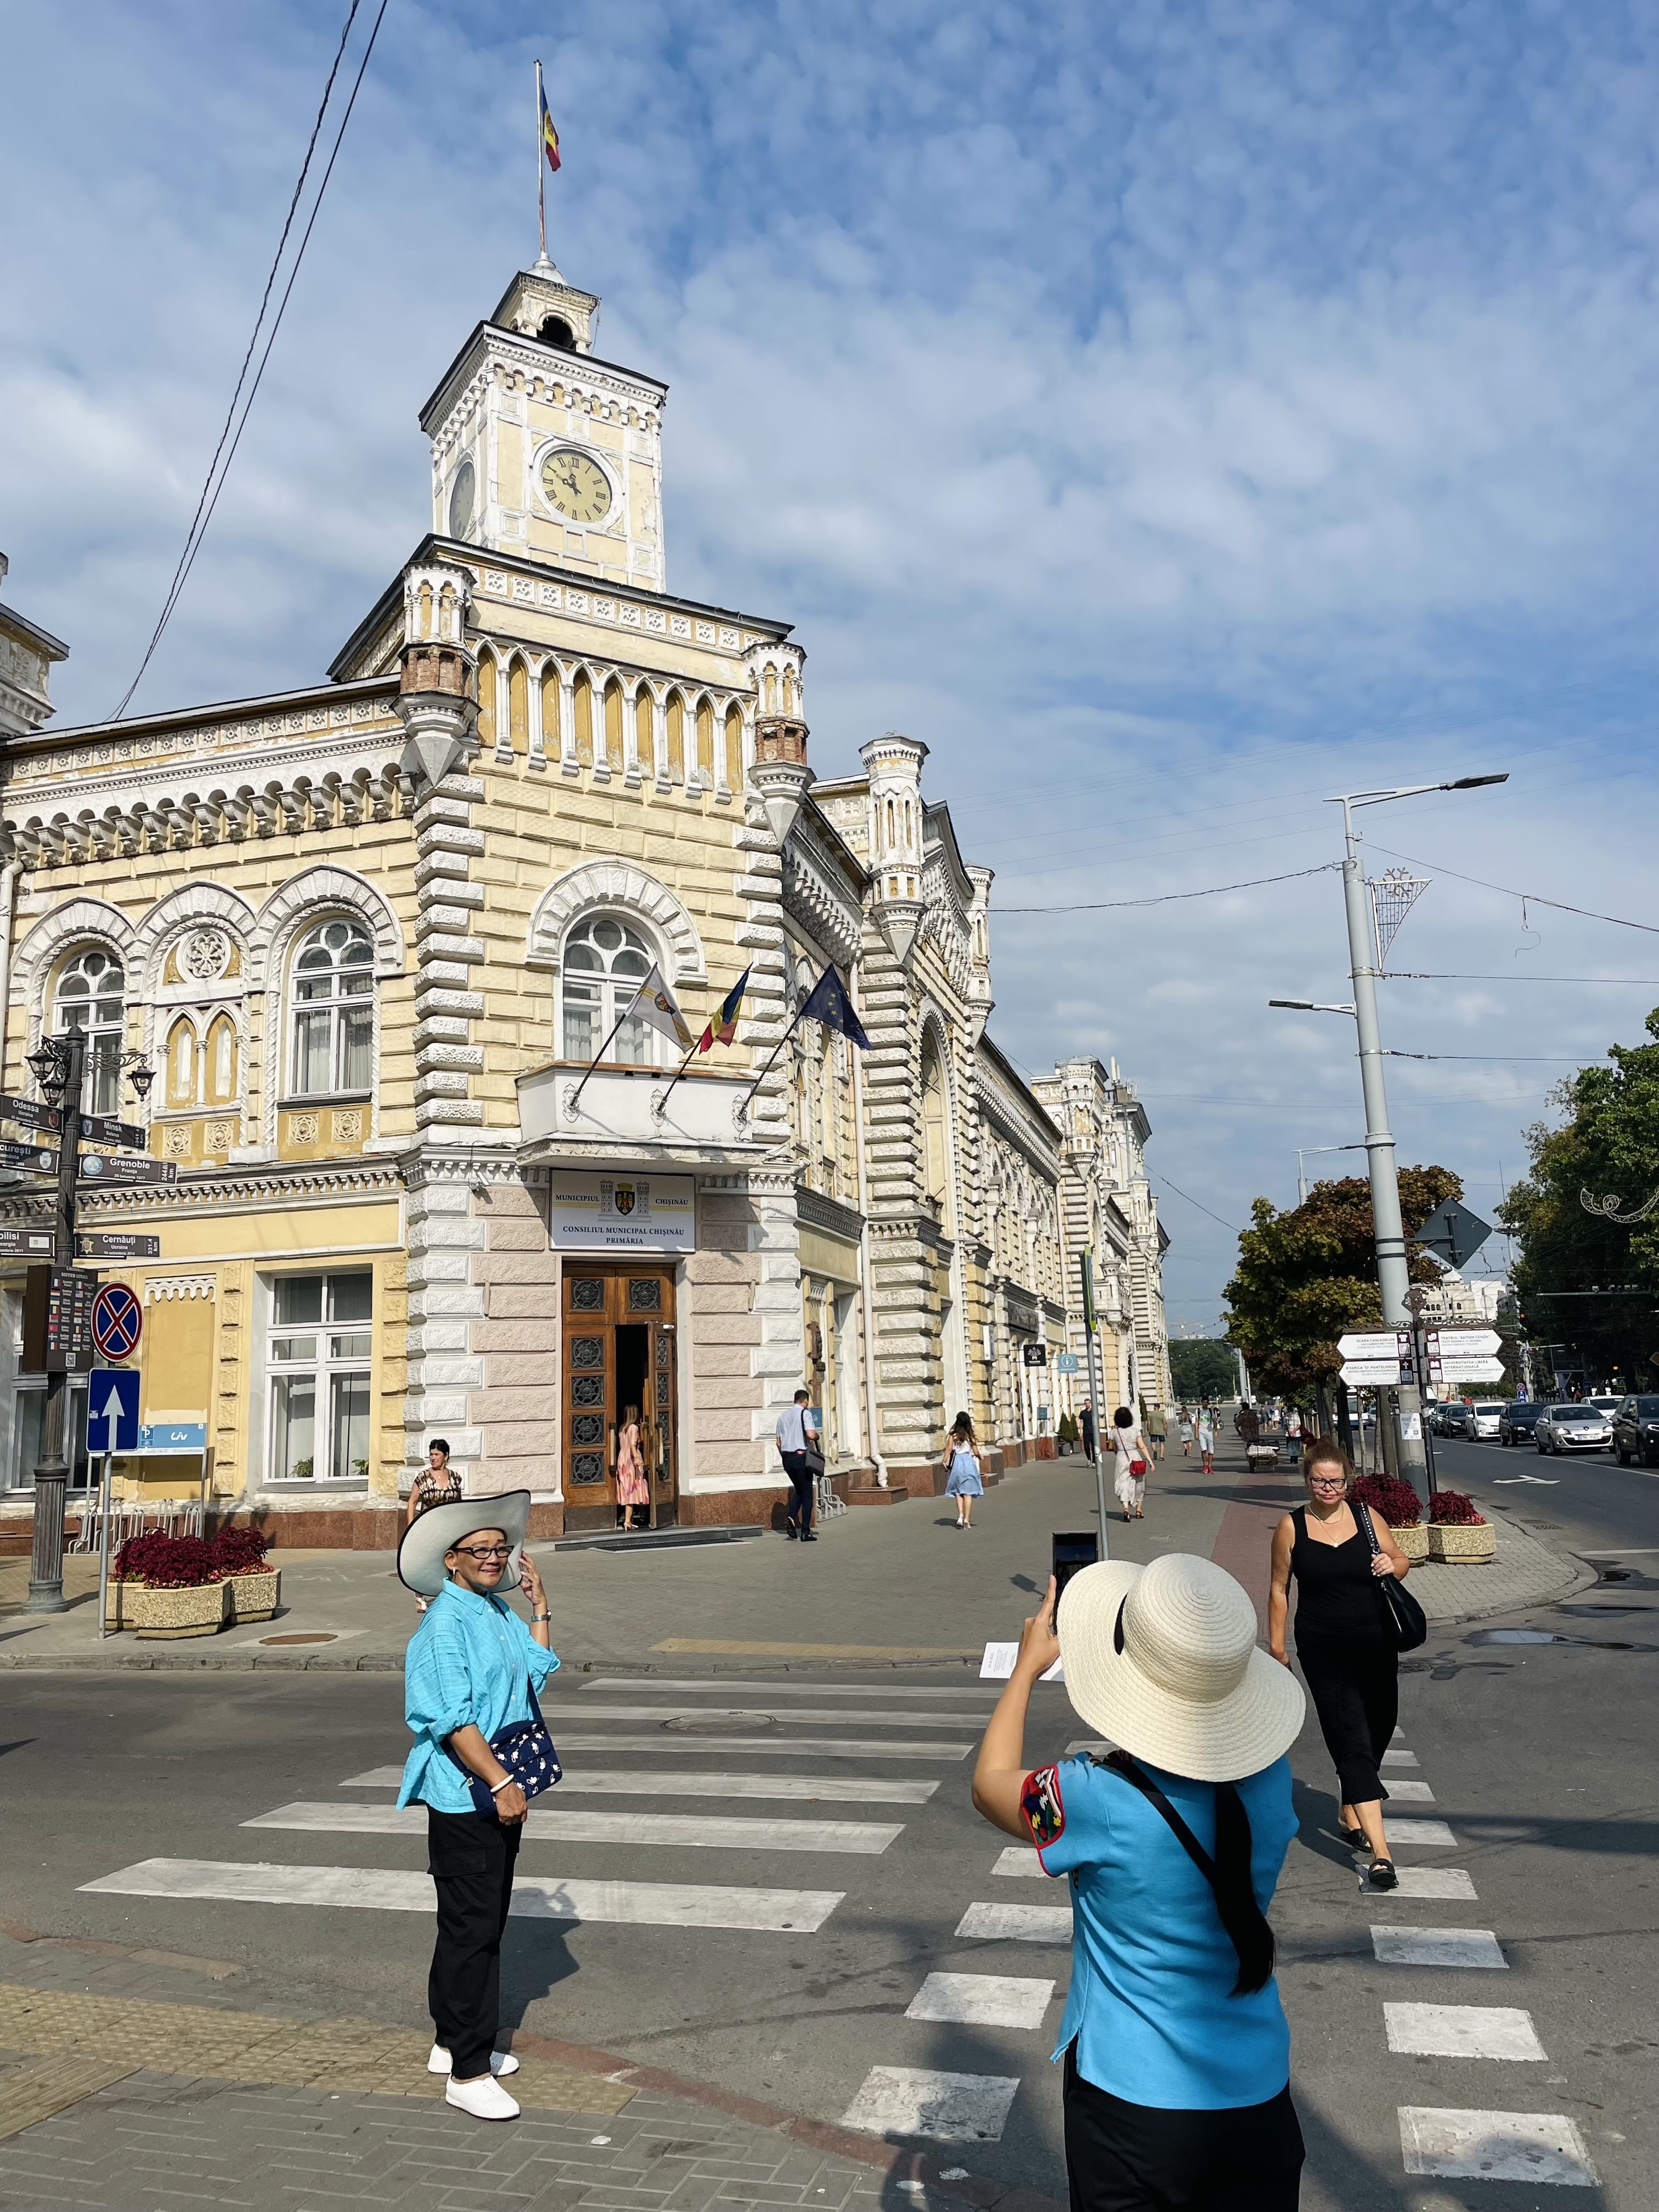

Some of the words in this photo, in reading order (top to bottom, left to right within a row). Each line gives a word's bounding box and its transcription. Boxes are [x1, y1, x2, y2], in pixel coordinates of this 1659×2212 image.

[557, 457, 566, 468] XI
[596, 492, 606, 500] III
[13, 1099, 39, 1113] Odessa
[104, 1121, 122, 1132] Minsk
[110, 1158, 150, 1169] Grenoble
[168, 1168, 174, 1178] km
[103, 1235, 136, 1246] Cernăuți
[153, 1242, 158, 1252] km
[171, 1431, 188, 1441] Liv
